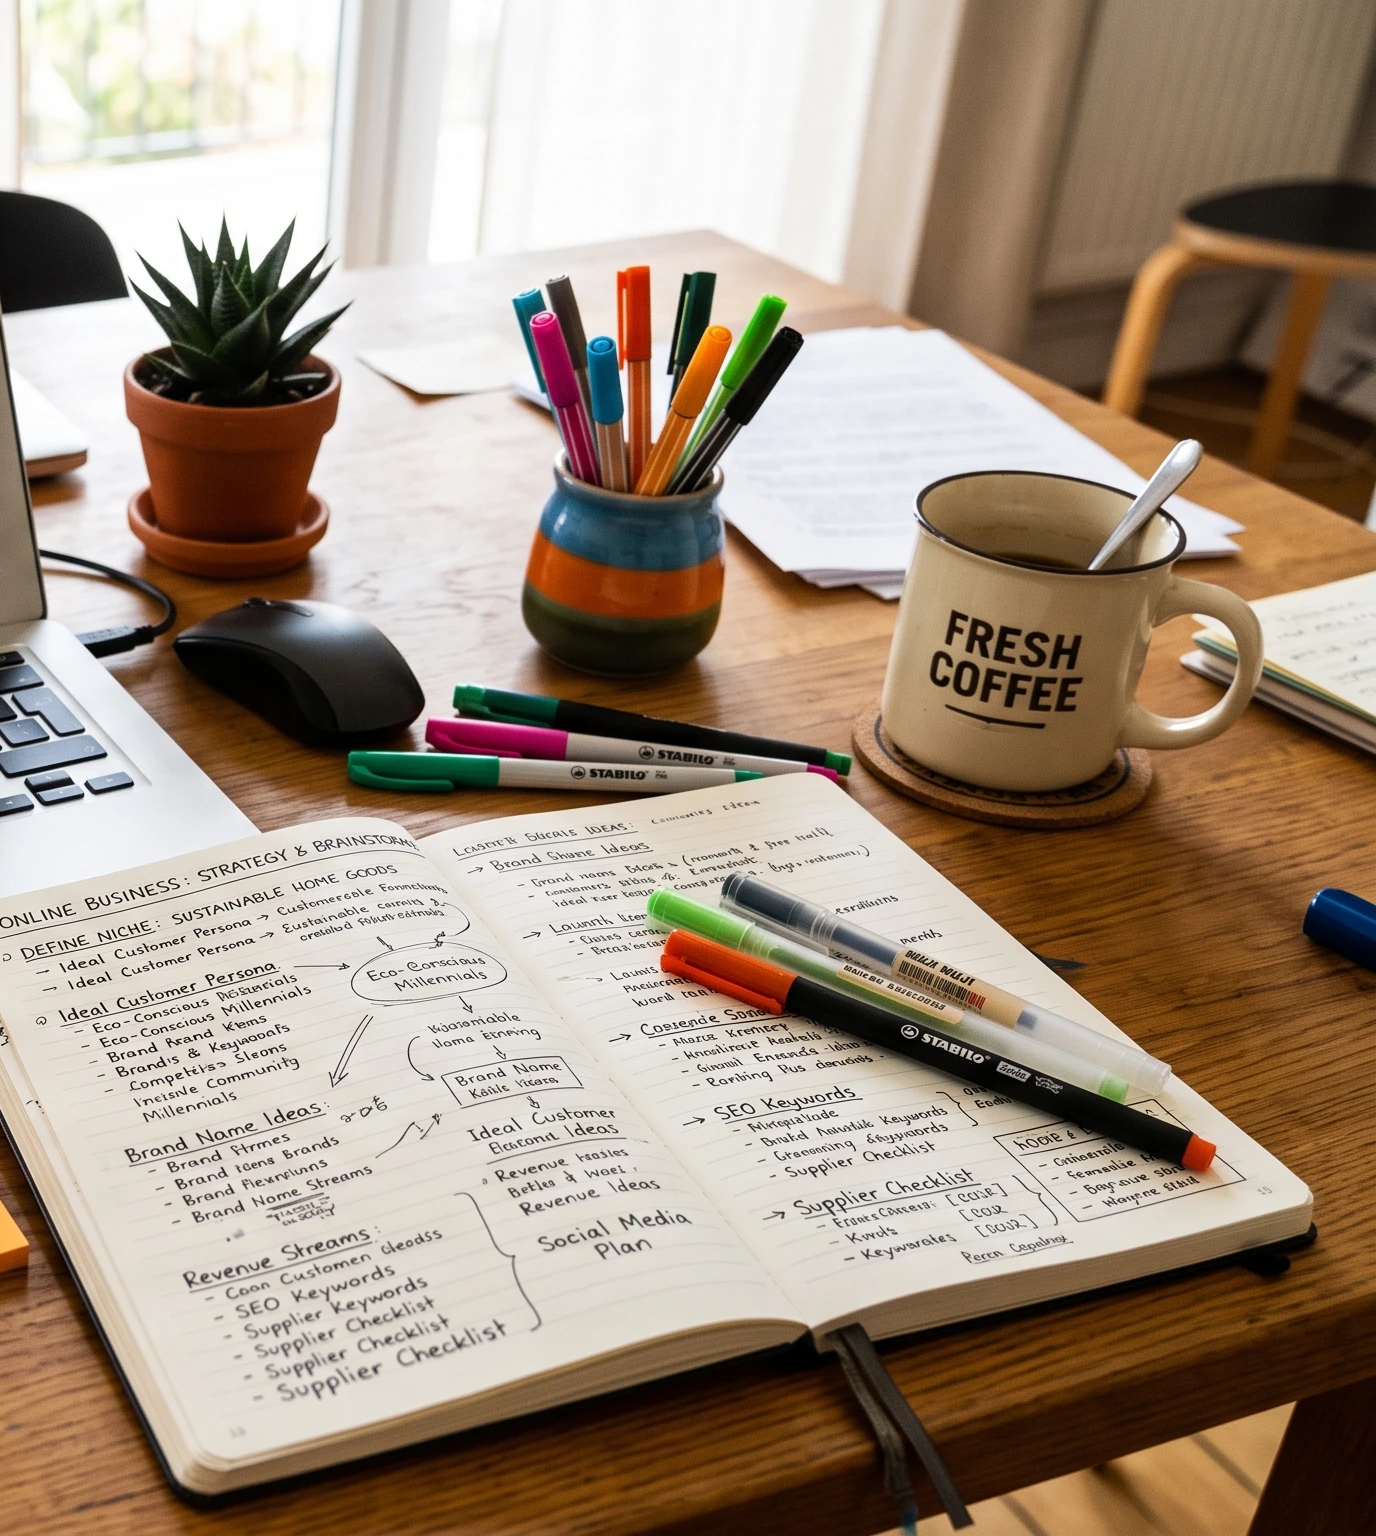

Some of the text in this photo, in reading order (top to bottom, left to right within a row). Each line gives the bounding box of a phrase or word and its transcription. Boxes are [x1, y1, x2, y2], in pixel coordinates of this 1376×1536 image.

[944, 609, 1083, 671] FRESH
[929, 650, 1084, 713] COFFEE
[589, 767, 646, 781] STABILO
[657, 749, 715, 766] STABILO
[488, 850, 543, 875] Brand
[601, 838, 652, 858] Ideas
[84, 876, 191, 912] BUSINESS:
[197, 849, 289, 882] STRATEGY
[20, 864, 399, 961] DEFINE NICHE: SUSTAINABLE HOME GOODS
[58, 917, 253, 974] Ideal Customer Persona
[67, 971, 113, 991] Ideal
[120, 951, 193, 979] Customer
[197, 935, 257, 958] Persona
[393, 968, 489, 995] Millennials
[57, 1000, 109, 1024] Ideal
[116, 981, 197, 1011] Customer
[221, 985, 312, 1019] Millennials
[108, 1042, 159, 1066] Brand
[187, 1048, 201, 1059] &
[920, 1032, 985, 1064] STABILO
[206, 1056, 301, 1089] Community
[454, 1066, 507, 1089] Brand
[142, 1091, 238, 1124] Millennials
[713, 1085, 857, 1121] SEO Keywords
[878, 1104, 949, 1127] Keywords
[124, 1136, 189, 1164] Brand
[195, 1120, 259, 1148] Name
[466, 1116, 523, 1145] Ideal
[531, 1105, 617, 1129] Customer
[563, 1121, 621, 1141] Ideas
[166, 1149, 224, 1175] Brand
[174, 1134, 341, 1192] Brand Brands
[493, 1156, 570, 1184] Revenue
[784, 1153, 855, 1183] Supplier
[181, 1183, 236, 1208] Brand
[190, 1199, 247, 1225] Brand
[306, 1165, 374, 1192] Streams
[518, 1176, 663, 1217] Revenue Ideas
[792, 1167, 975, 1220] Supplier Checklist
[537, 1208, 694, 1253] Social Media
[594, 1237, 655, 1261] Plan
[182, 1256, 275, 1290] Revenue
[234, 1263, 397, 1321] SEO Keywords
[243, 1275, 430, 1346] Supplier Keywords
[254, 1294, 436, 1366] Supplier Checklist
[264, 1312, 451, 1386] Supplier Checklist
[276, 1317, 509, 1404] Supplier Checklist
